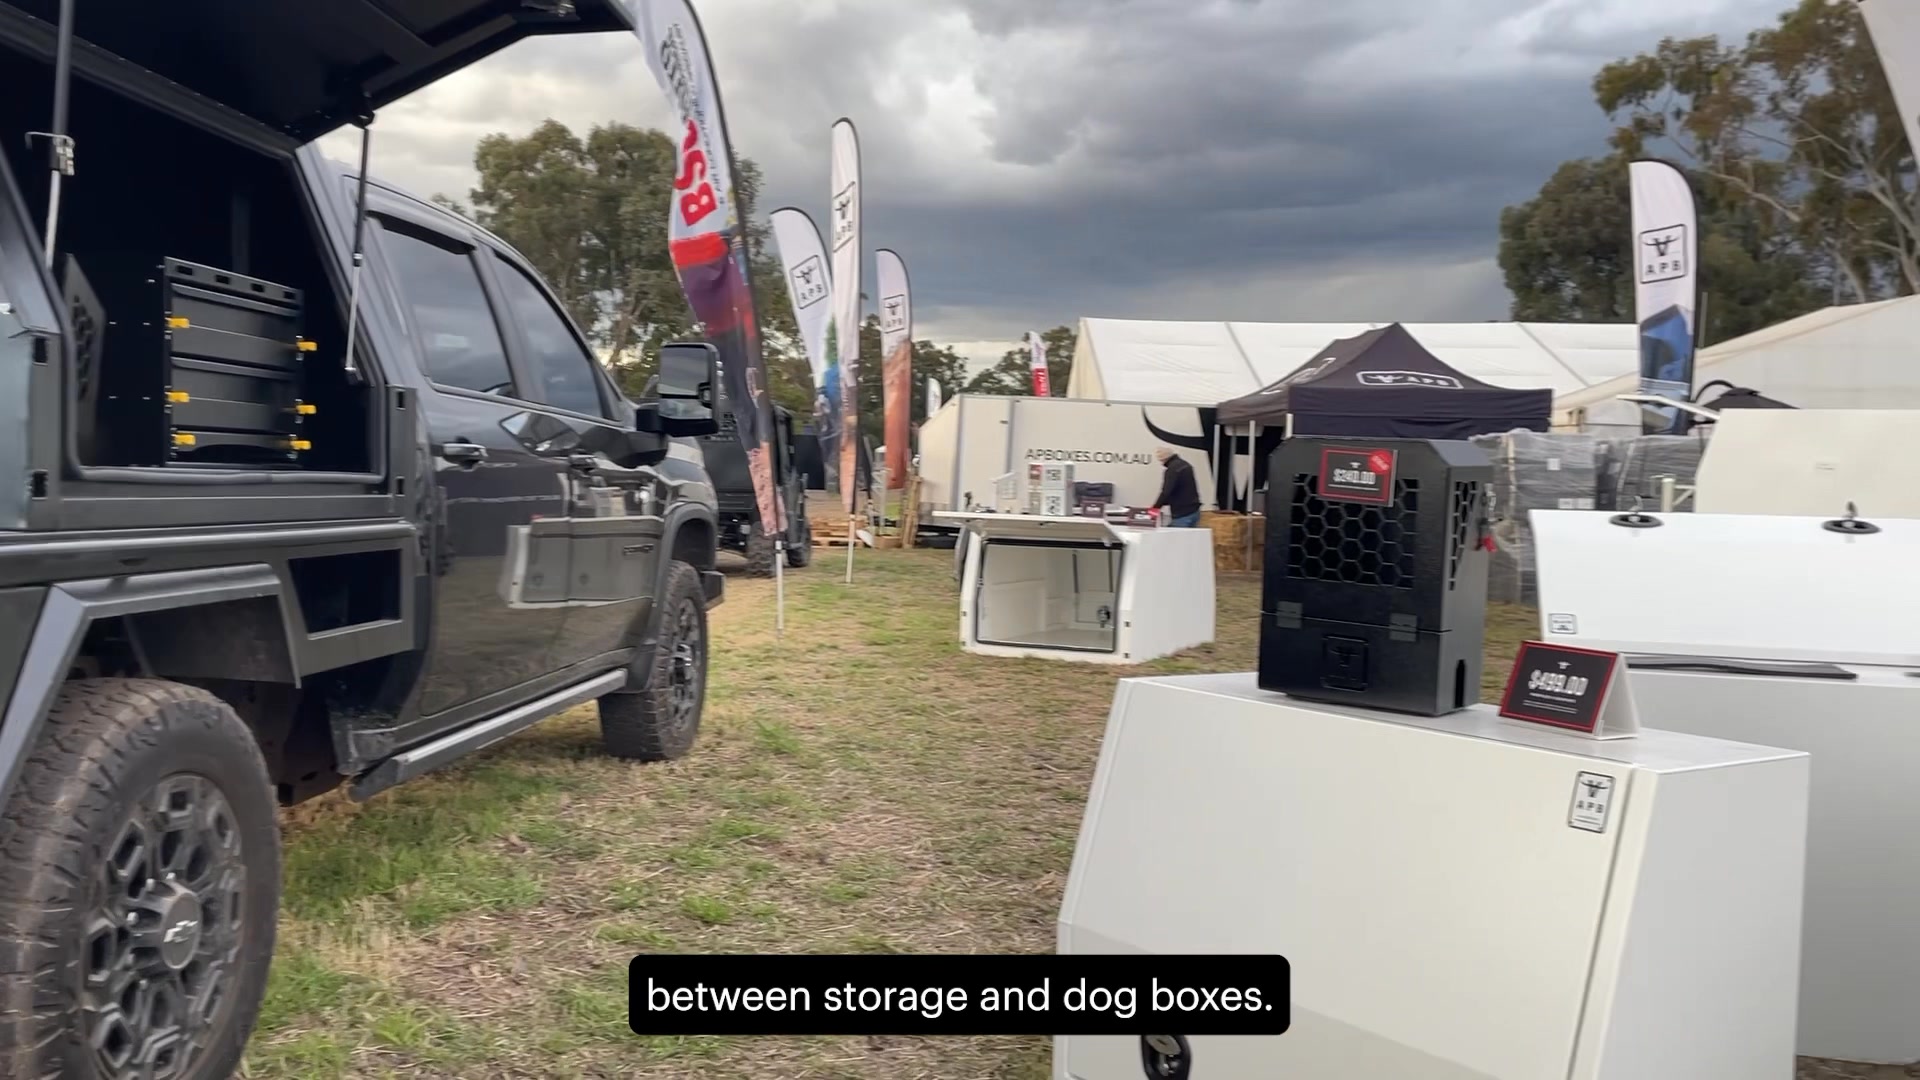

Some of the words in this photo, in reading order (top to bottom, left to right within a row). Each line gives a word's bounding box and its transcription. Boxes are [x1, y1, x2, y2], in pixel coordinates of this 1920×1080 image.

[1645, 260, 1681, 276] APB
[801, 284, 823, 300] APB
[1407, 376, 1450, 386] APB
[1024, 448, 1152, 465] APBOXES.COM.AU
[1576, 800, 1604, 813] APB
